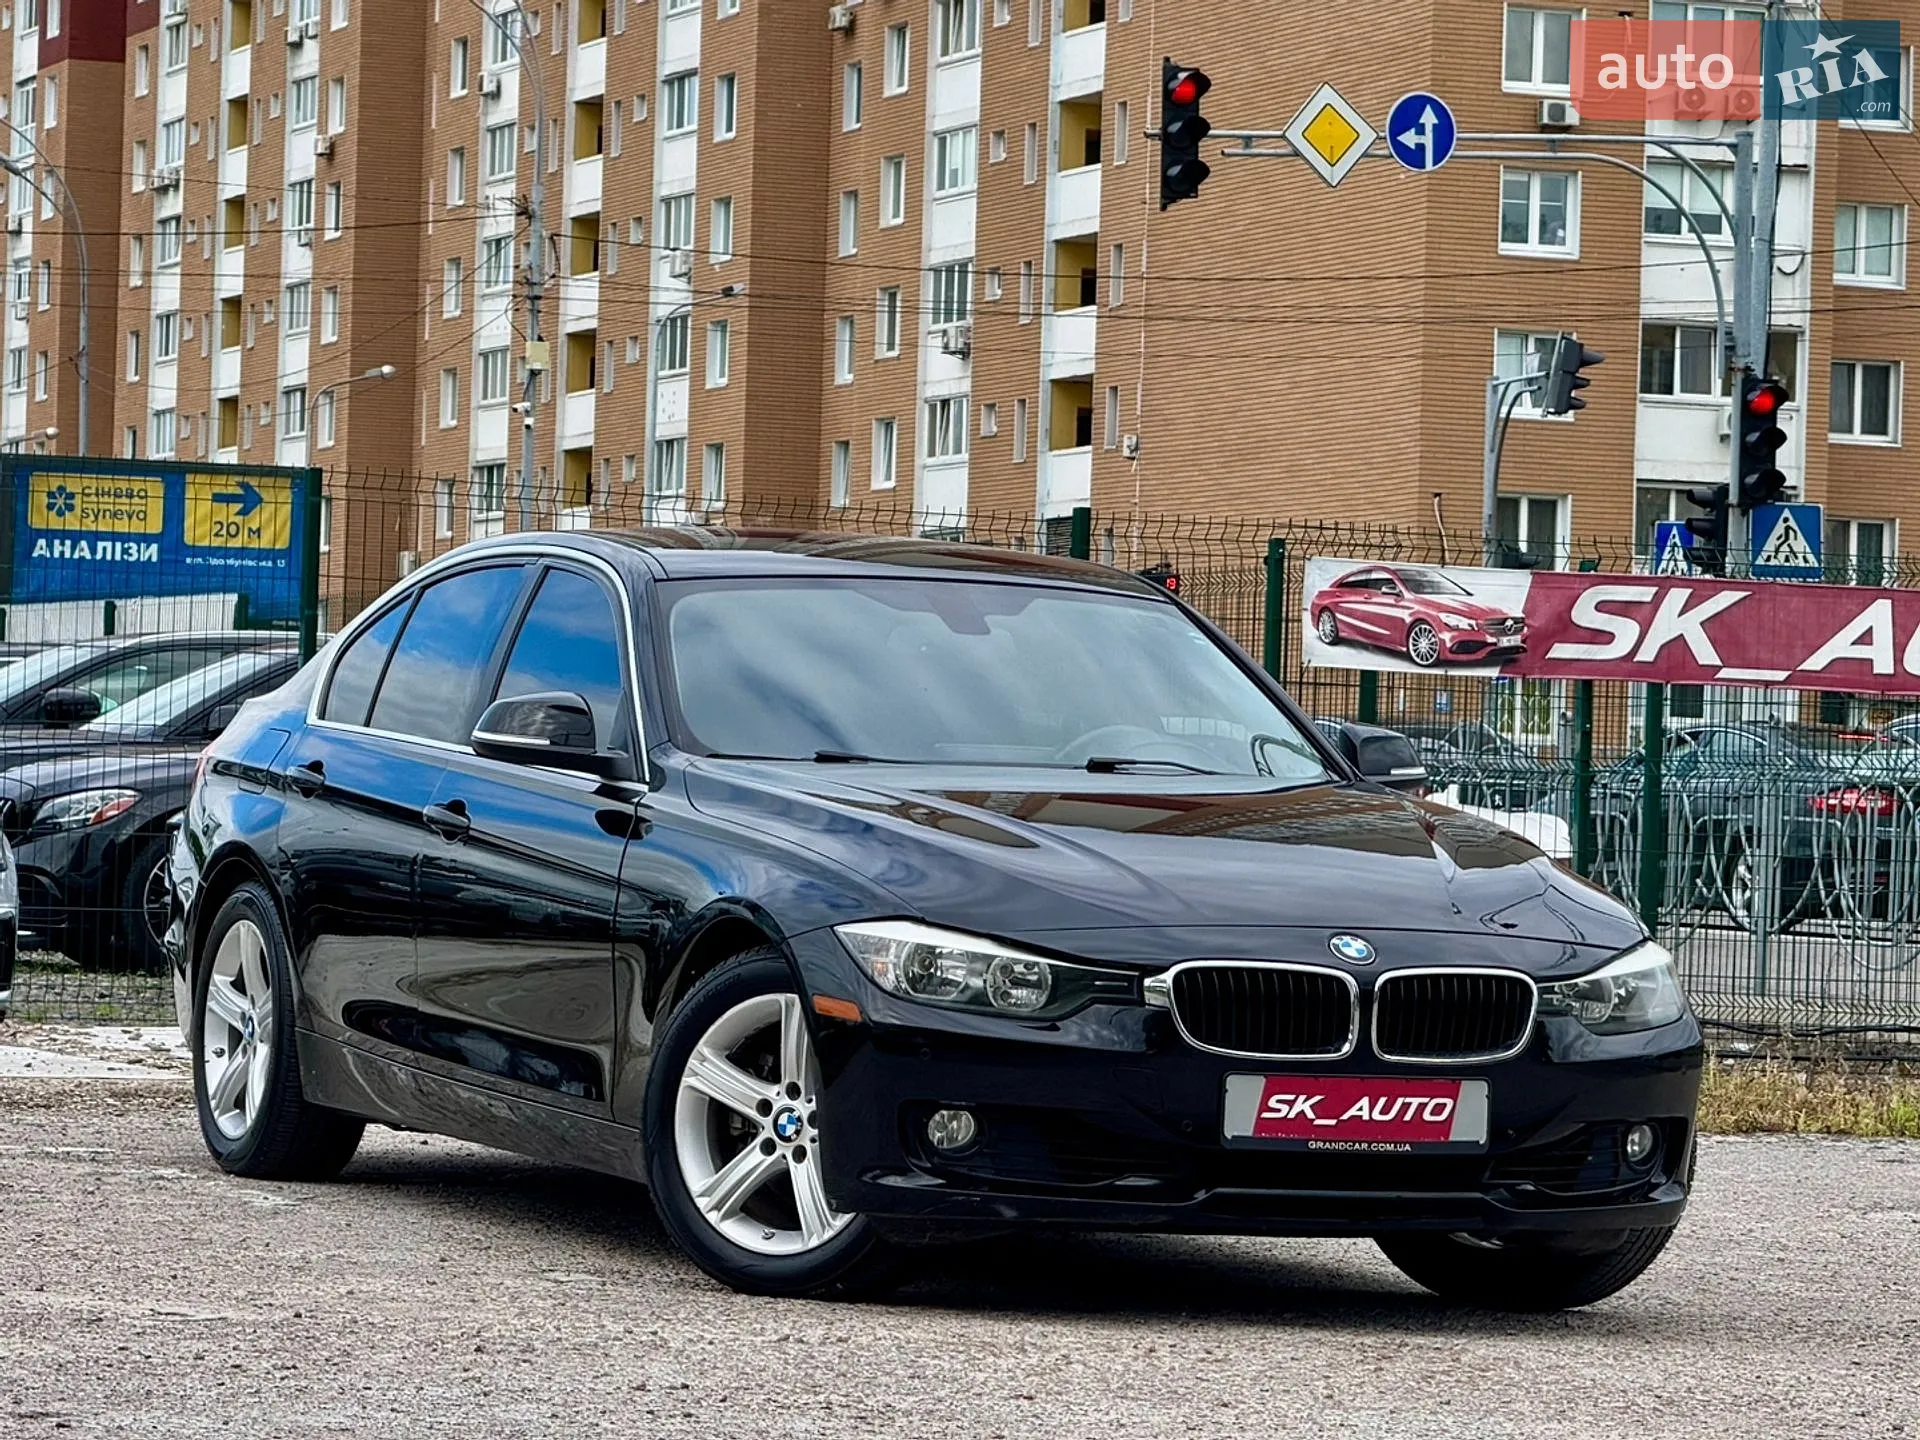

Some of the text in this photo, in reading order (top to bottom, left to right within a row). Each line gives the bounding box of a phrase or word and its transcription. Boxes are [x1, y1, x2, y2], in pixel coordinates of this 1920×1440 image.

[213, 521, 240, 538] 20
[32, 538, 158, 562] АНАЛІЗИ
[1261, 1094, 1454, 1126] SK_AUTO
[1308, 1140, 1412, 1151] GRANDCAR.COM.UA
